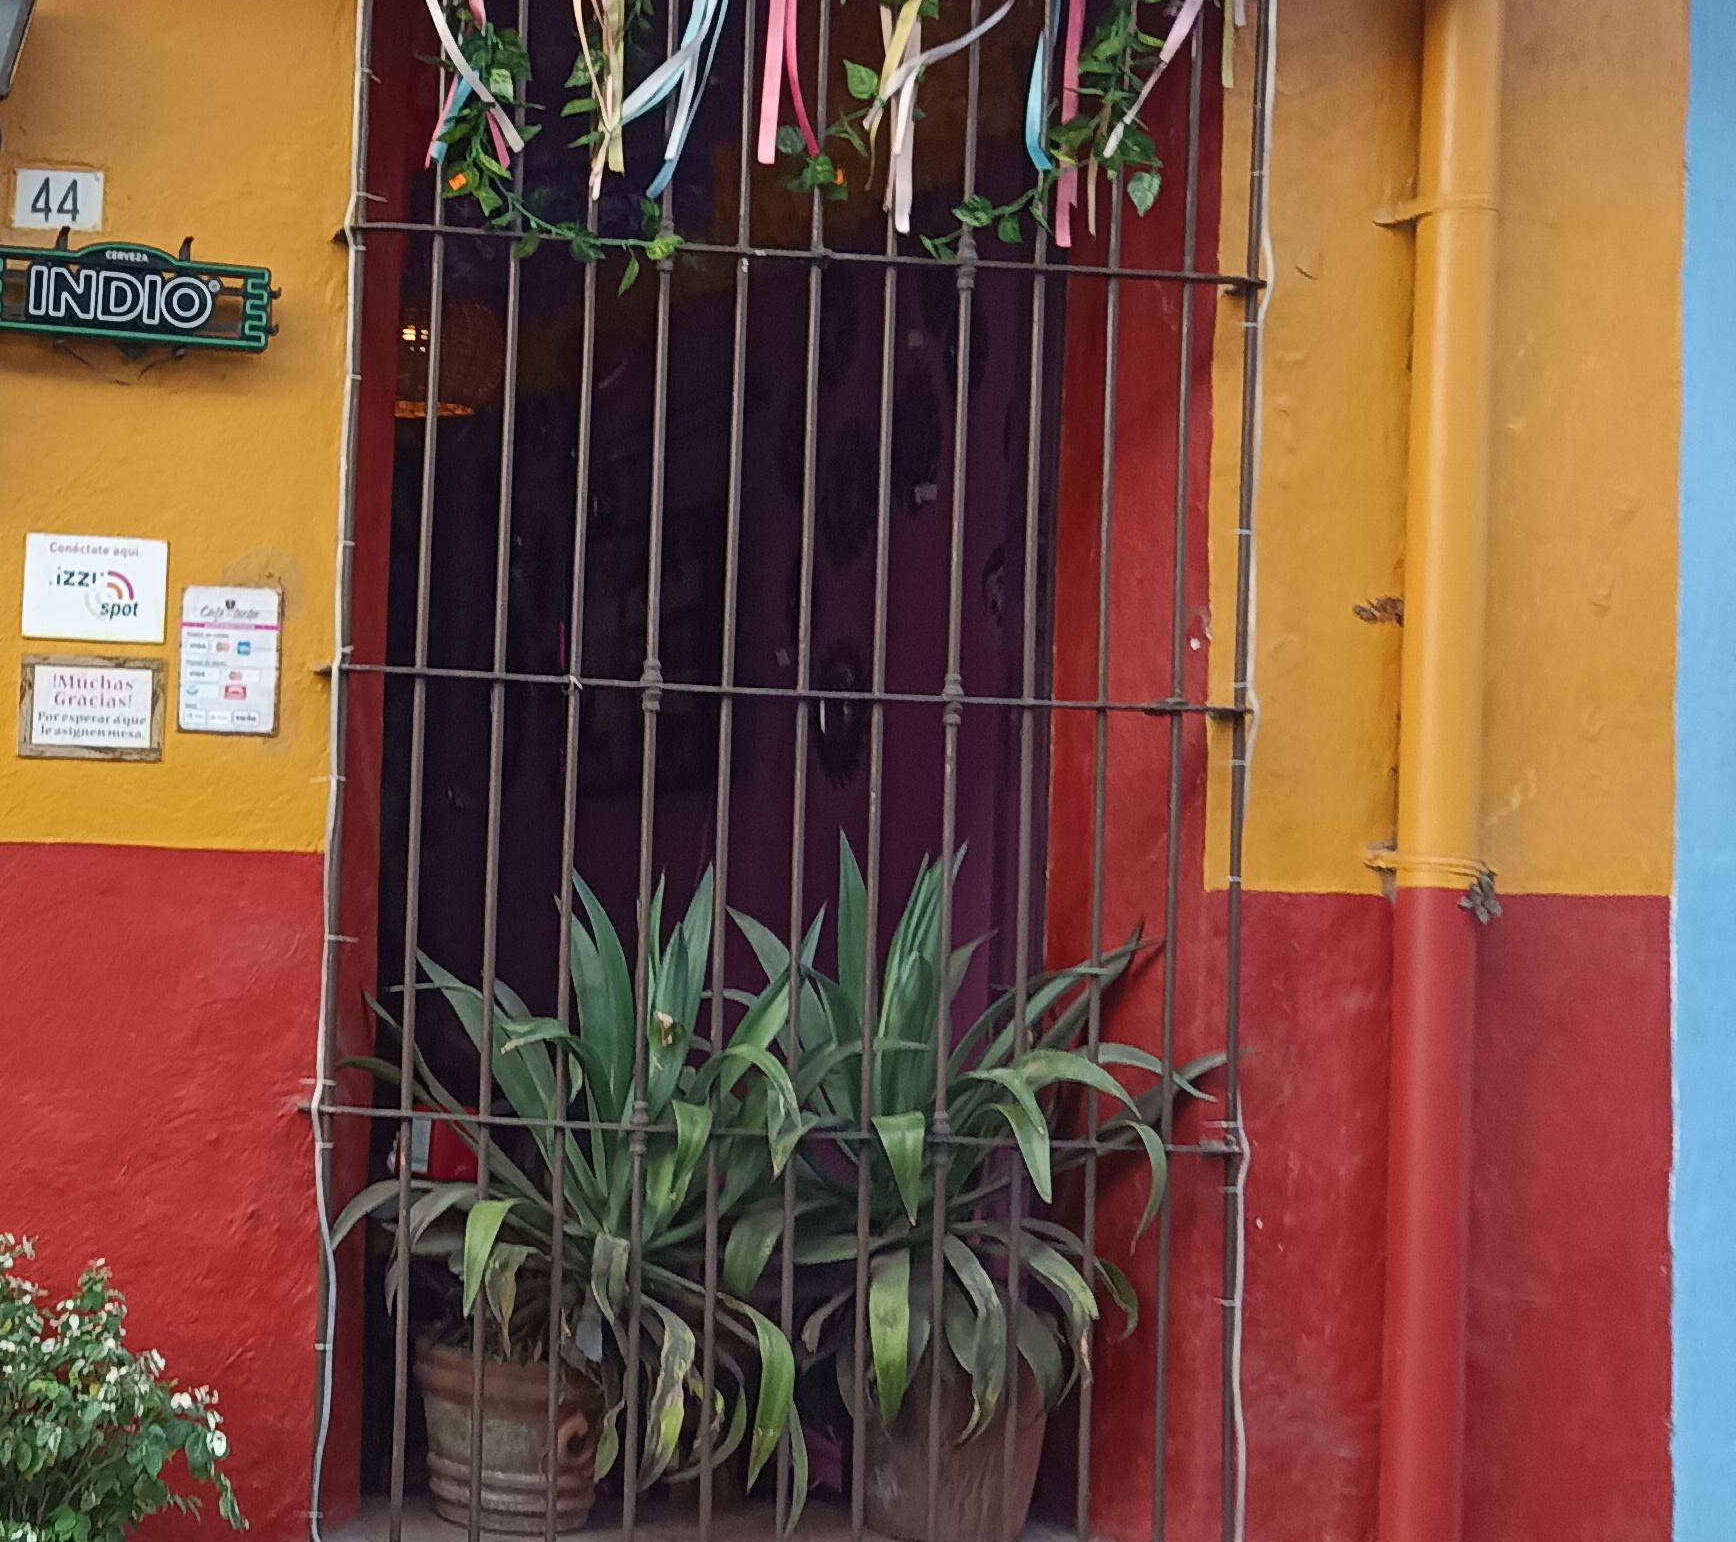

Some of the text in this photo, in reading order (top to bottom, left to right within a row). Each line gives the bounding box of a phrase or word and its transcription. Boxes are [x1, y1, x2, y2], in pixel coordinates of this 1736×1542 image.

[30, 176, 80, 223] 44
[105, 250, 149, 263] CERVEZA
[28, 264, 213, 329] INDIO
[49, 541, 110, 555] Conéctate
[100, 602, 139, 620] spot
[38, 711, 59, 722] Por
[61, 714, 110, 726] esperar
